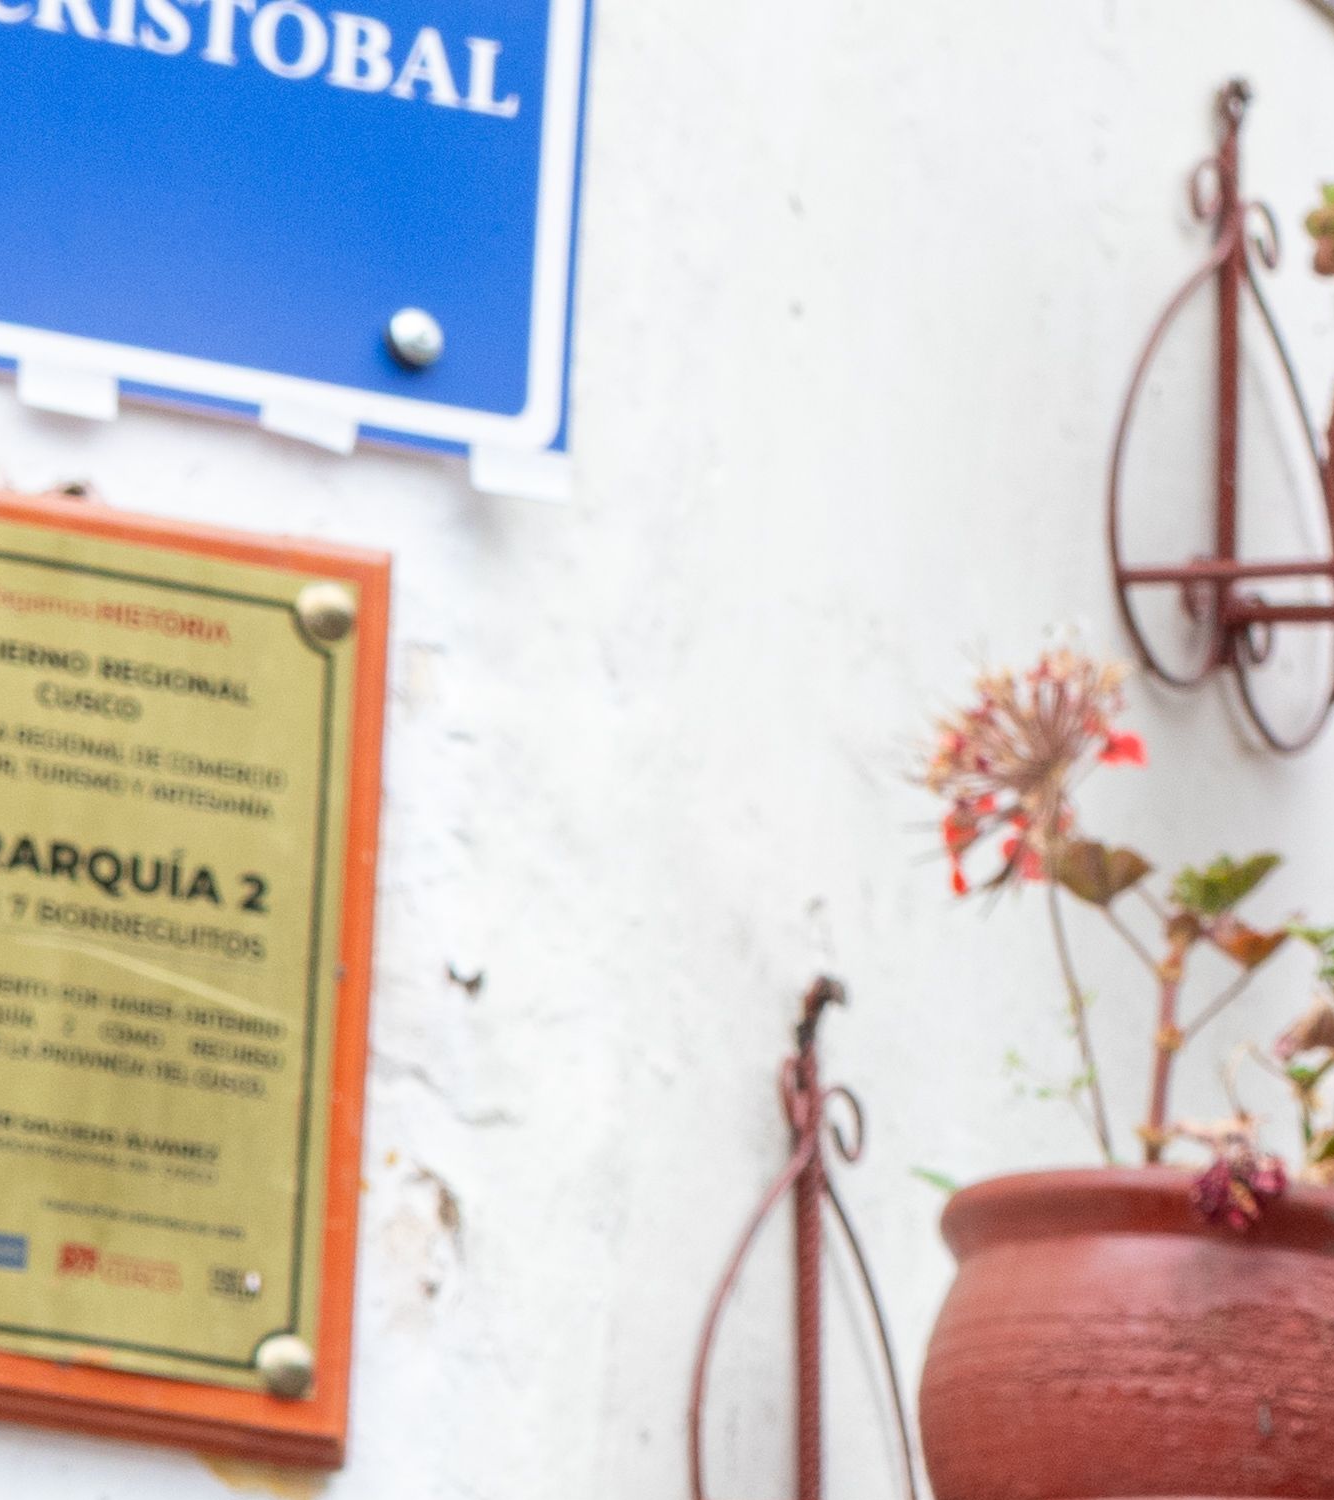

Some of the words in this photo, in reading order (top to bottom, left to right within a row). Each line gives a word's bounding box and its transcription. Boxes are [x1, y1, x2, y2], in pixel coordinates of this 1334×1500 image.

[98, 657, 253, 704] REGIONAL
[238, 873, 270, 912] 2
[9, 895, 27, 920] 7
[36, 899, 266, 961] BORREGUITOS
